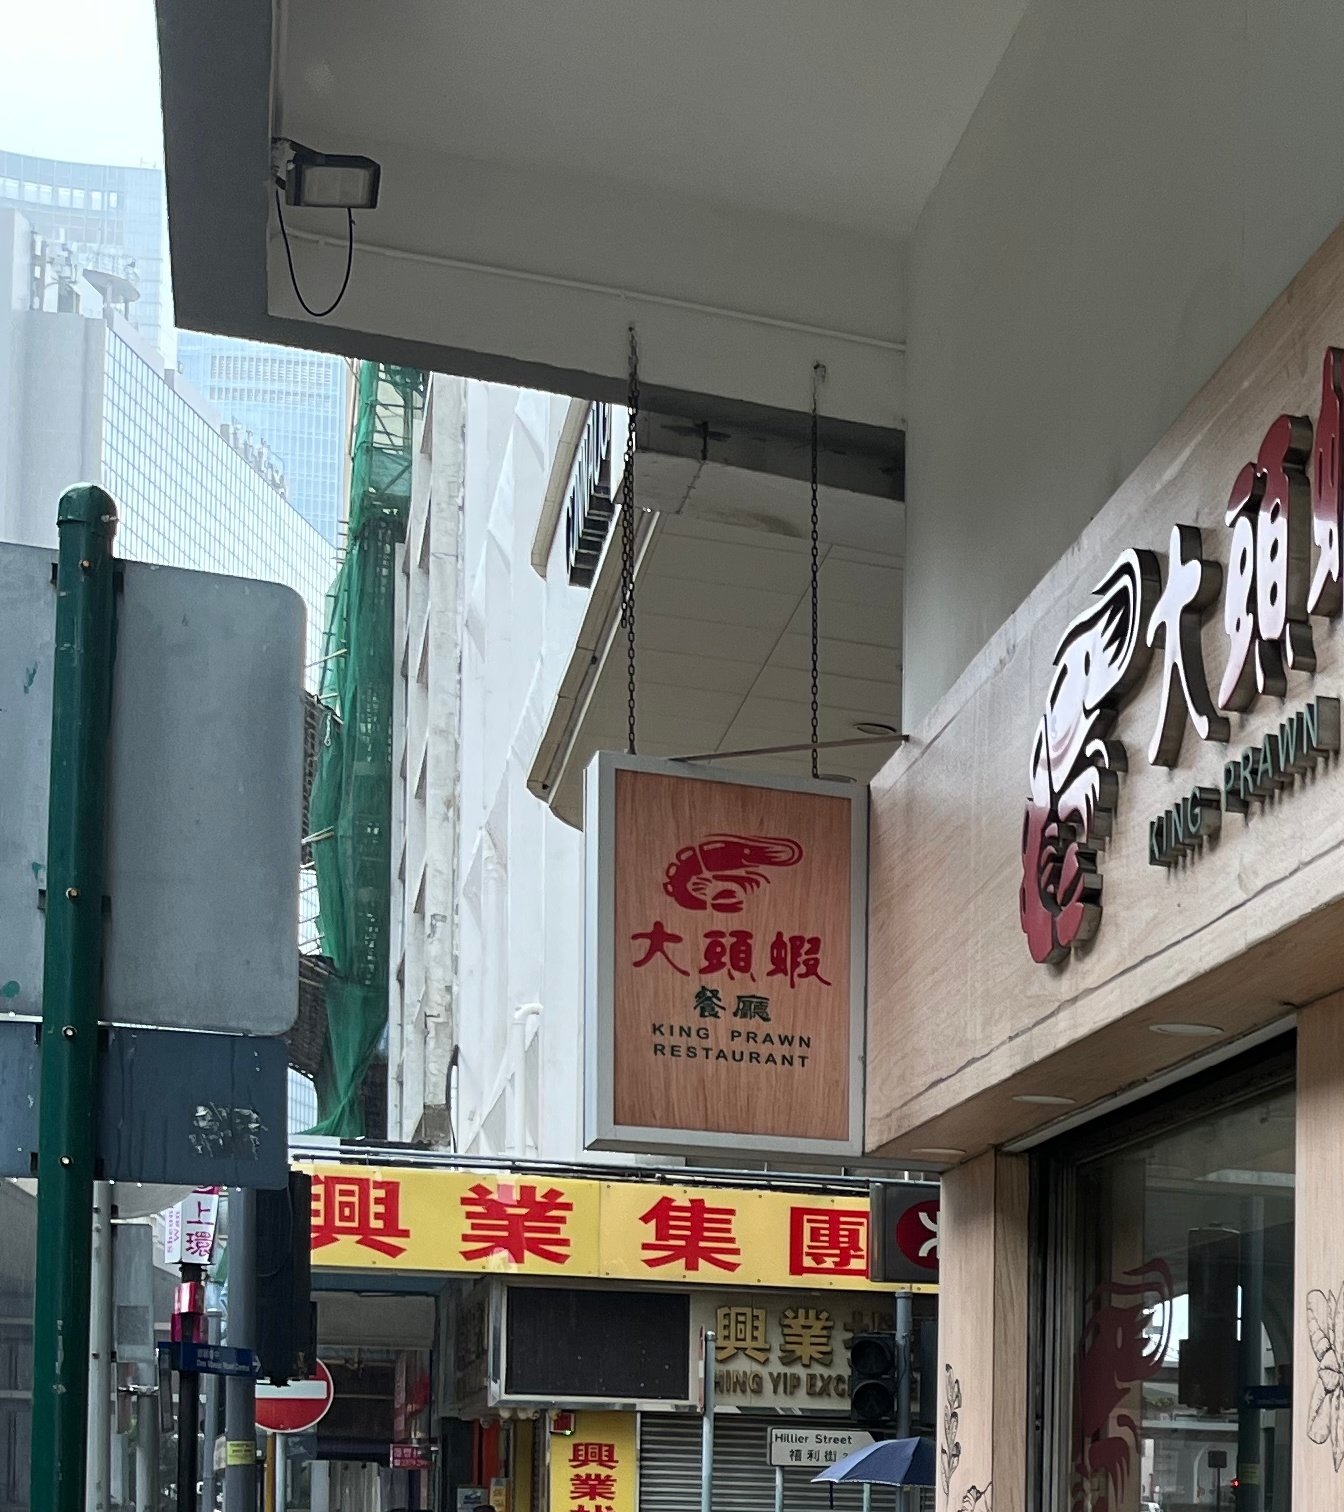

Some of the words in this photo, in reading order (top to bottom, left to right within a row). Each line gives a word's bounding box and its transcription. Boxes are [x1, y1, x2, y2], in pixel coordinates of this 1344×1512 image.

[1149, 785, 1216, 866] KING
[1223, 700, 1337, 810] PRAWN
[630, 920, 832, 988] 大頭蝦
[693, 985, 772, 1022] 餐廳
[652, 1023, 711, 1040] KING
[731, 1030, 812, 1048] PRAWN
[653, 1043, 810, 1068] RESTAURANT
[310, 1174, 870, 1279] 興業集團
[769, 1371, 800, 1395] YIP
[806, 1373, 850, 1397] EXC
[774, 1433, 809, 1444] Hillier
[815, 1434, 853, 1445] Street
